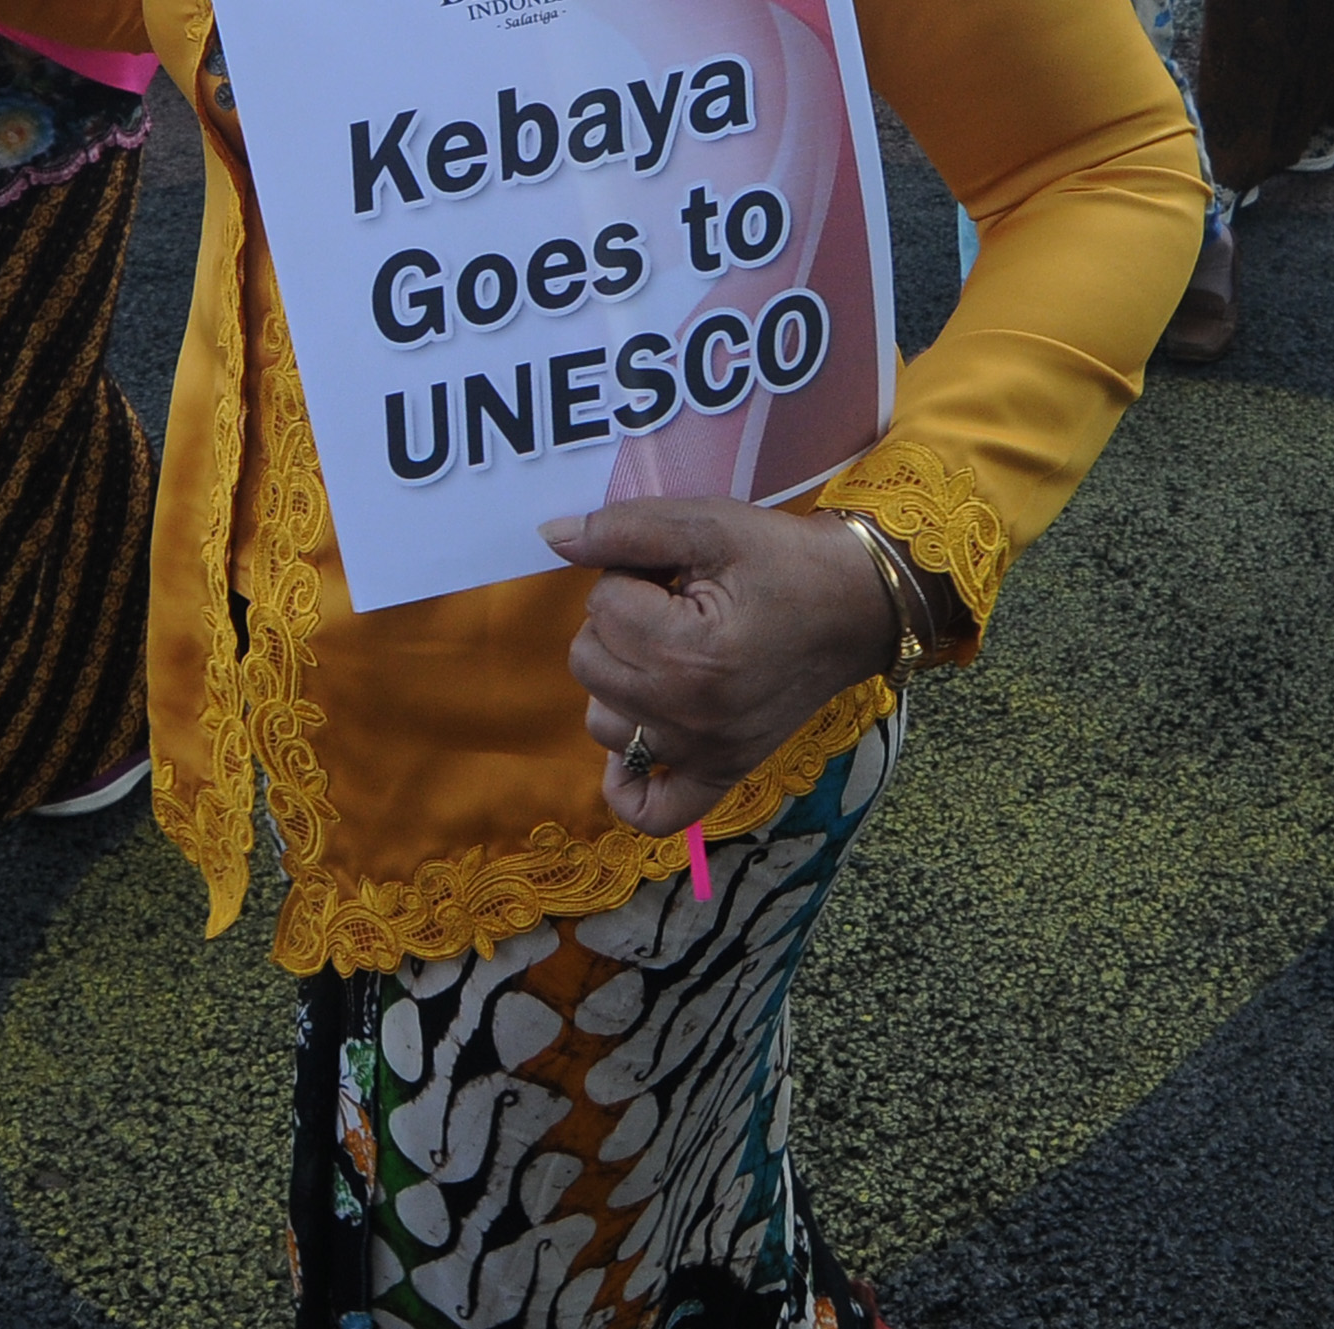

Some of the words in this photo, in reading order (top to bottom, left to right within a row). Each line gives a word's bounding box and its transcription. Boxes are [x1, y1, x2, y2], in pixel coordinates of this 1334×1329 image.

[349, 59, 750, 214] Kebaya
[371, 222, 644, 344] Goes
[680, 186, 785, 273] to
[384, 293, 825, 481] UNESCO
